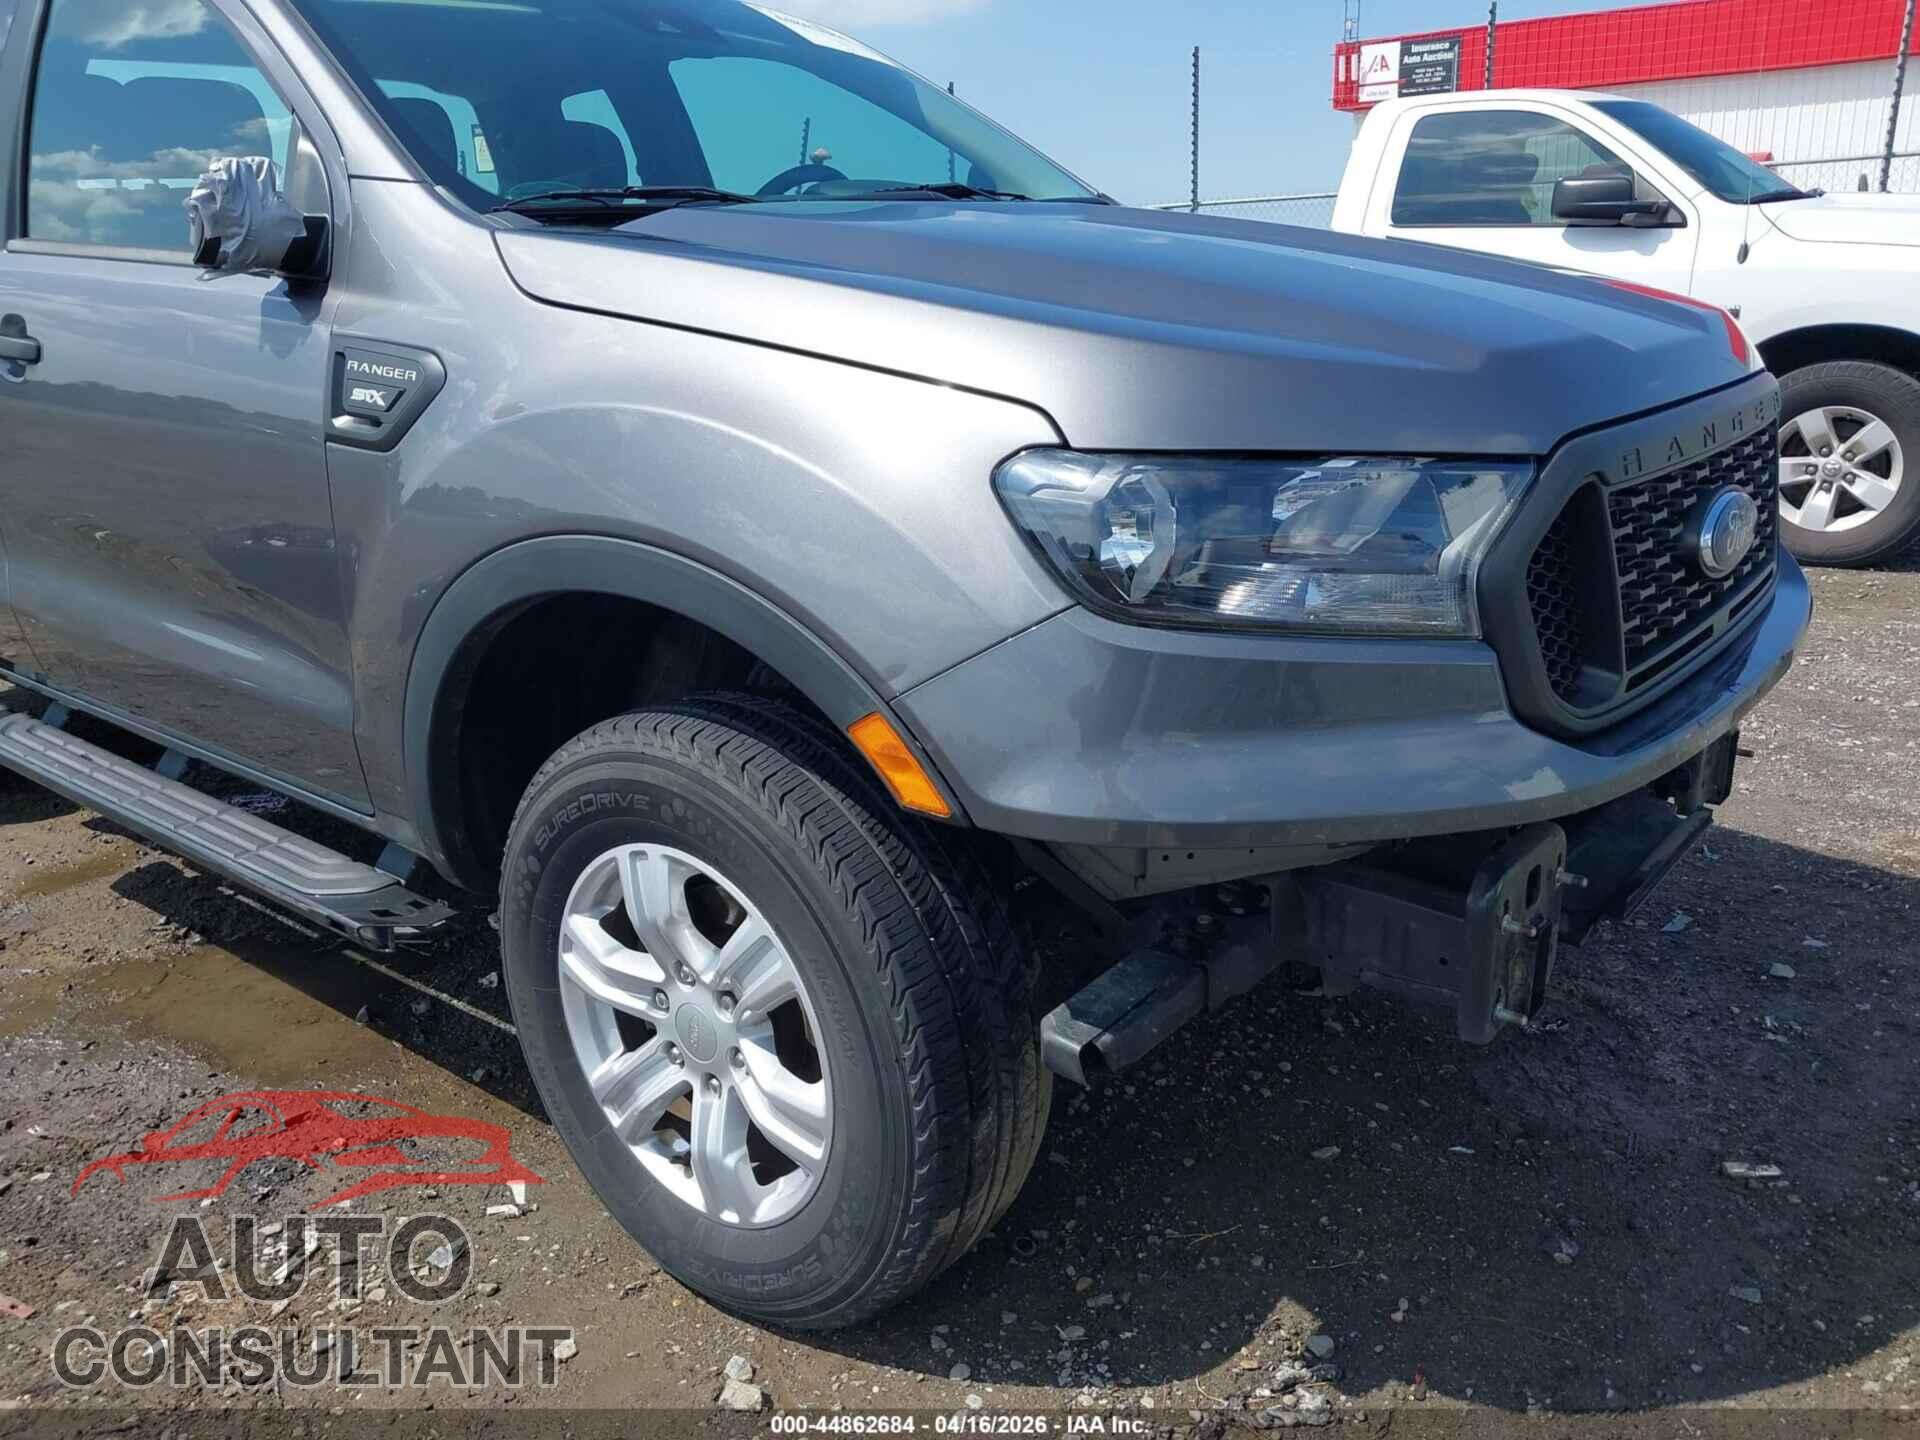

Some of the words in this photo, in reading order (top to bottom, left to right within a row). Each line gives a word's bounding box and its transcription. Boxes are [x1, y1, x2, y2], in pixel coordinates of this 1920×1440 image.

[1411, 42, 1450, 53] Insurance
[1403, 55, 1421, 65] Auto
[347, 360, 417, 381] RANGER
[350, 387, 387, 406] STX
